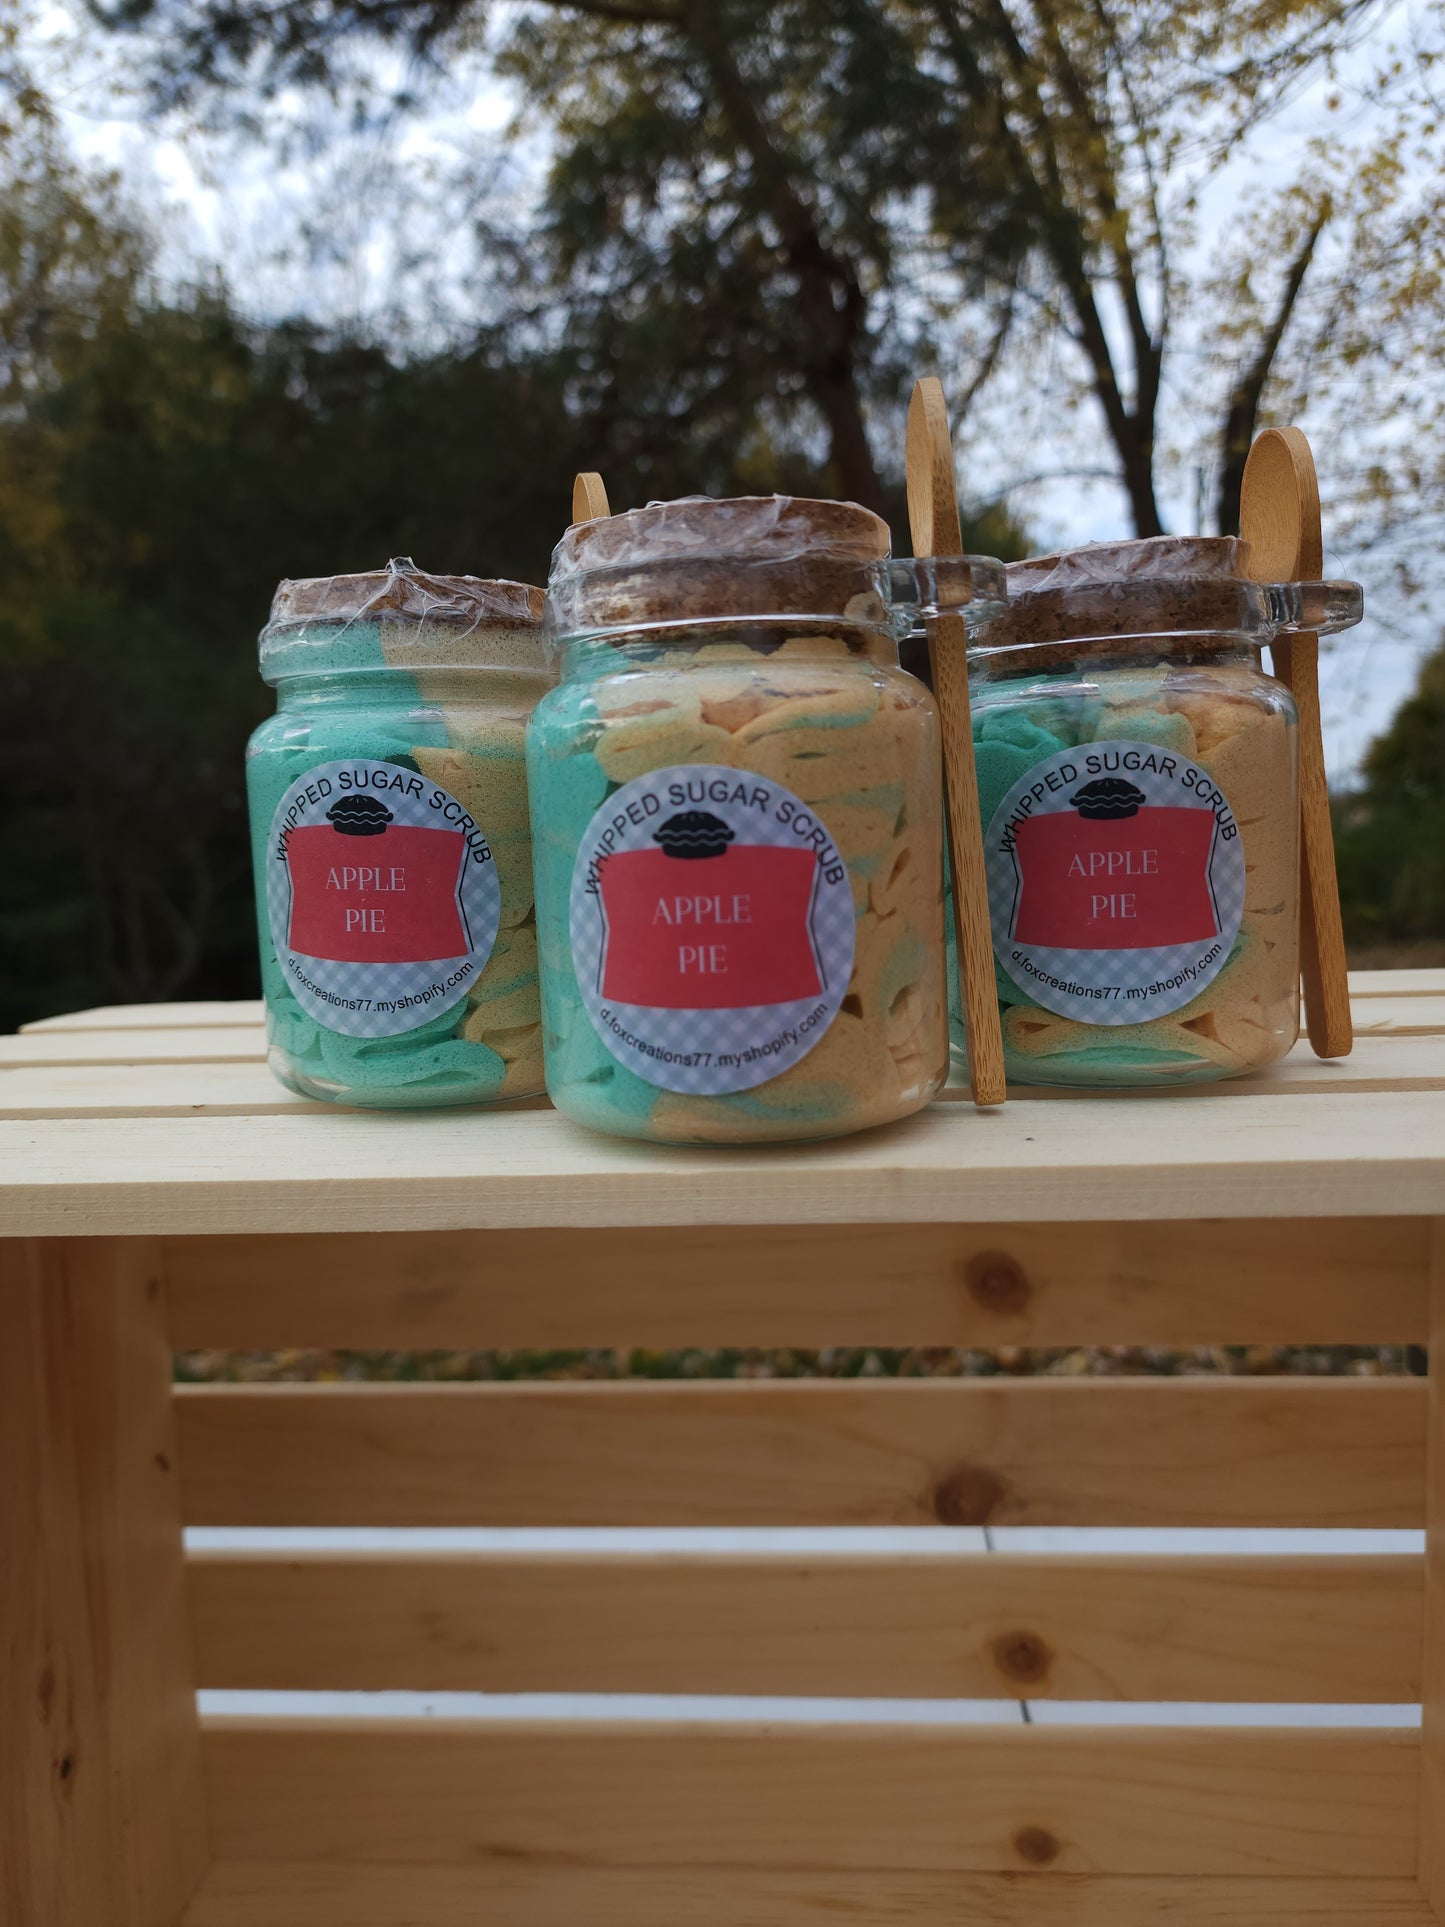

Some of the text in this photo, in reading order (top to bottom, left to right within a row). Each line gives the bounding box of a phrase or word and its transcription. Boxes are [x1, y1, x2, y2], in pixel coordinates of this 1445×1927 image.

[276, 769, 492, 864] WHIPPED SUGAR SCRUB
[999, 751, 1238, 853] WHIPPED SUGAR SCRUB
[585, 780, 845, 896] WHIPPED SUGAR SCRUB
[325, 867, 406, 891] APPLE
[1067, 849, 1159, 877] APPLE
[345, 909, 386, 933] PIE
[652, 894, 752, 925] APPLE
[1090, 894, 1137, 919] PIE
[678, 944, 728, 974] PIE
[1012, 943, 1222, 1000] d.foxcreations77.myshopify.com
[288, 958, 474, 1013] d.foxcreations77.myshopify.com
[600, 1002, 829, 1068] d.foxcreations77.myshopify.com
